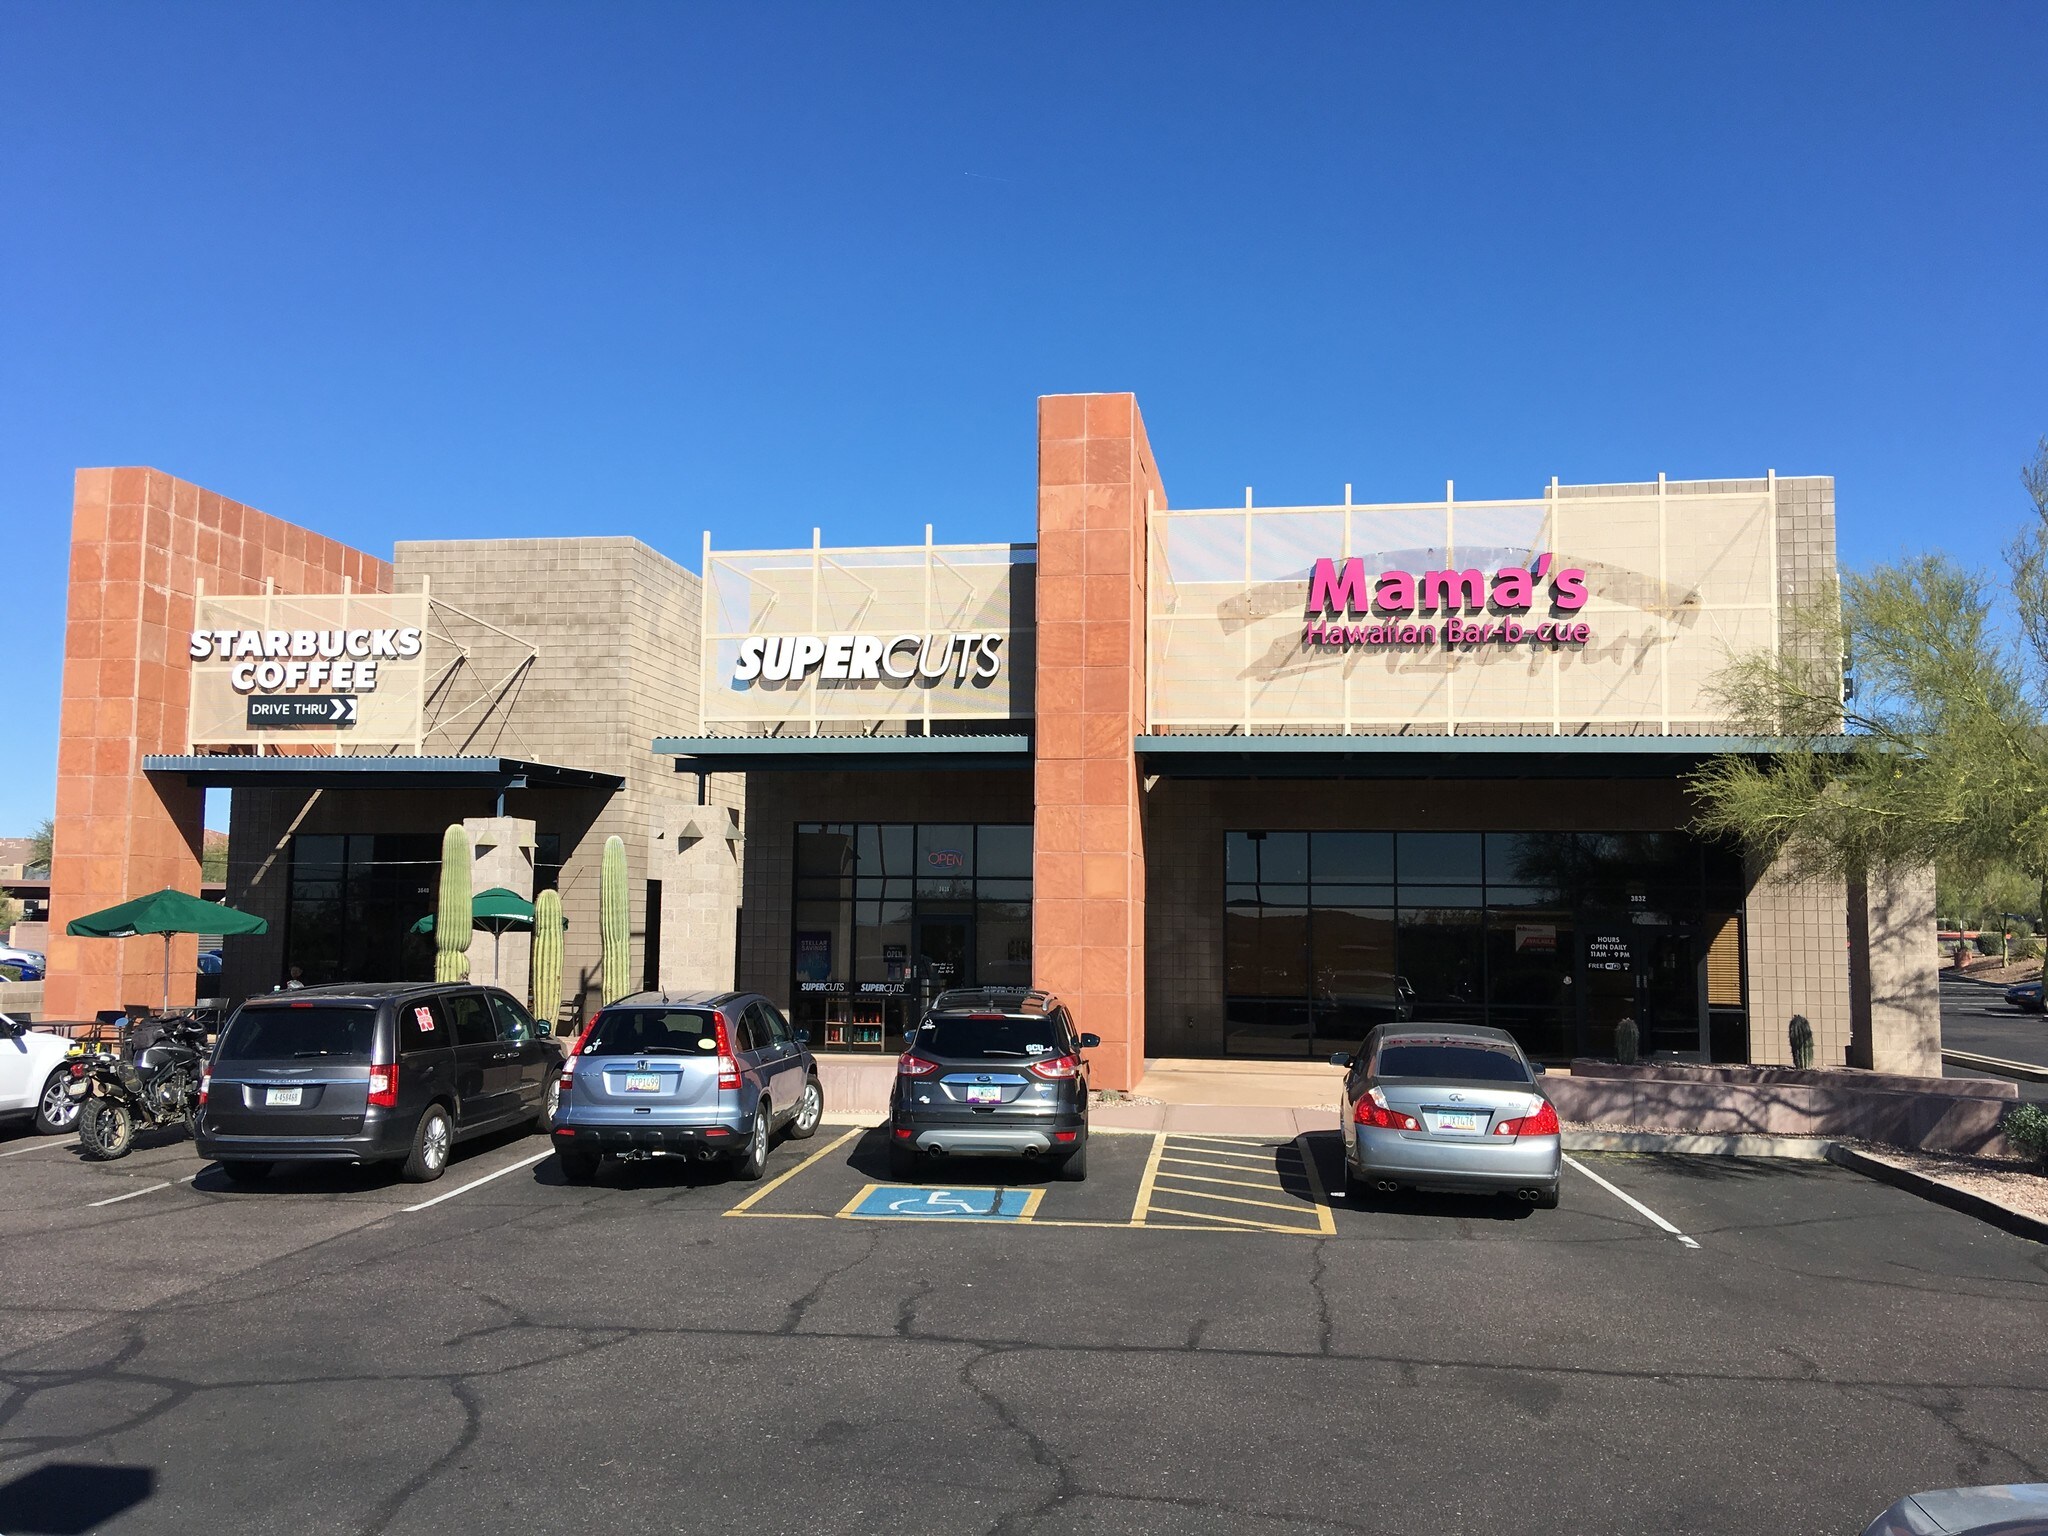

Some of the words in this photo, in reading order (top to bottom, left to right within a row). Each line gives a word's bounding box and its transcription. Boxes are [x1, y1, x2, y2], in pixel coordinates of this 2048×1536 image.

[1308, 552, 1588, 614] Mama's
[1306, 618, 1436, 645] Hawaiian
[1447, 616, 1590, 644] Bar-b-cue
[190, 628, 422, 658] STARBUCKS
[734, 634, 1002, 681] SUPERCUTS
[231, 661, 377, 691] COFFEE
[252, 704, 290, 715] DRIVE
[293, 703, 328, 715] THRU
[928, 852, 963, 866] OPEN
[886, 950, 903, 958] OPEN
[800, 982, 845, 992] SUPERCUTS
[860, 982, 905, 994] SUPERCUTS
